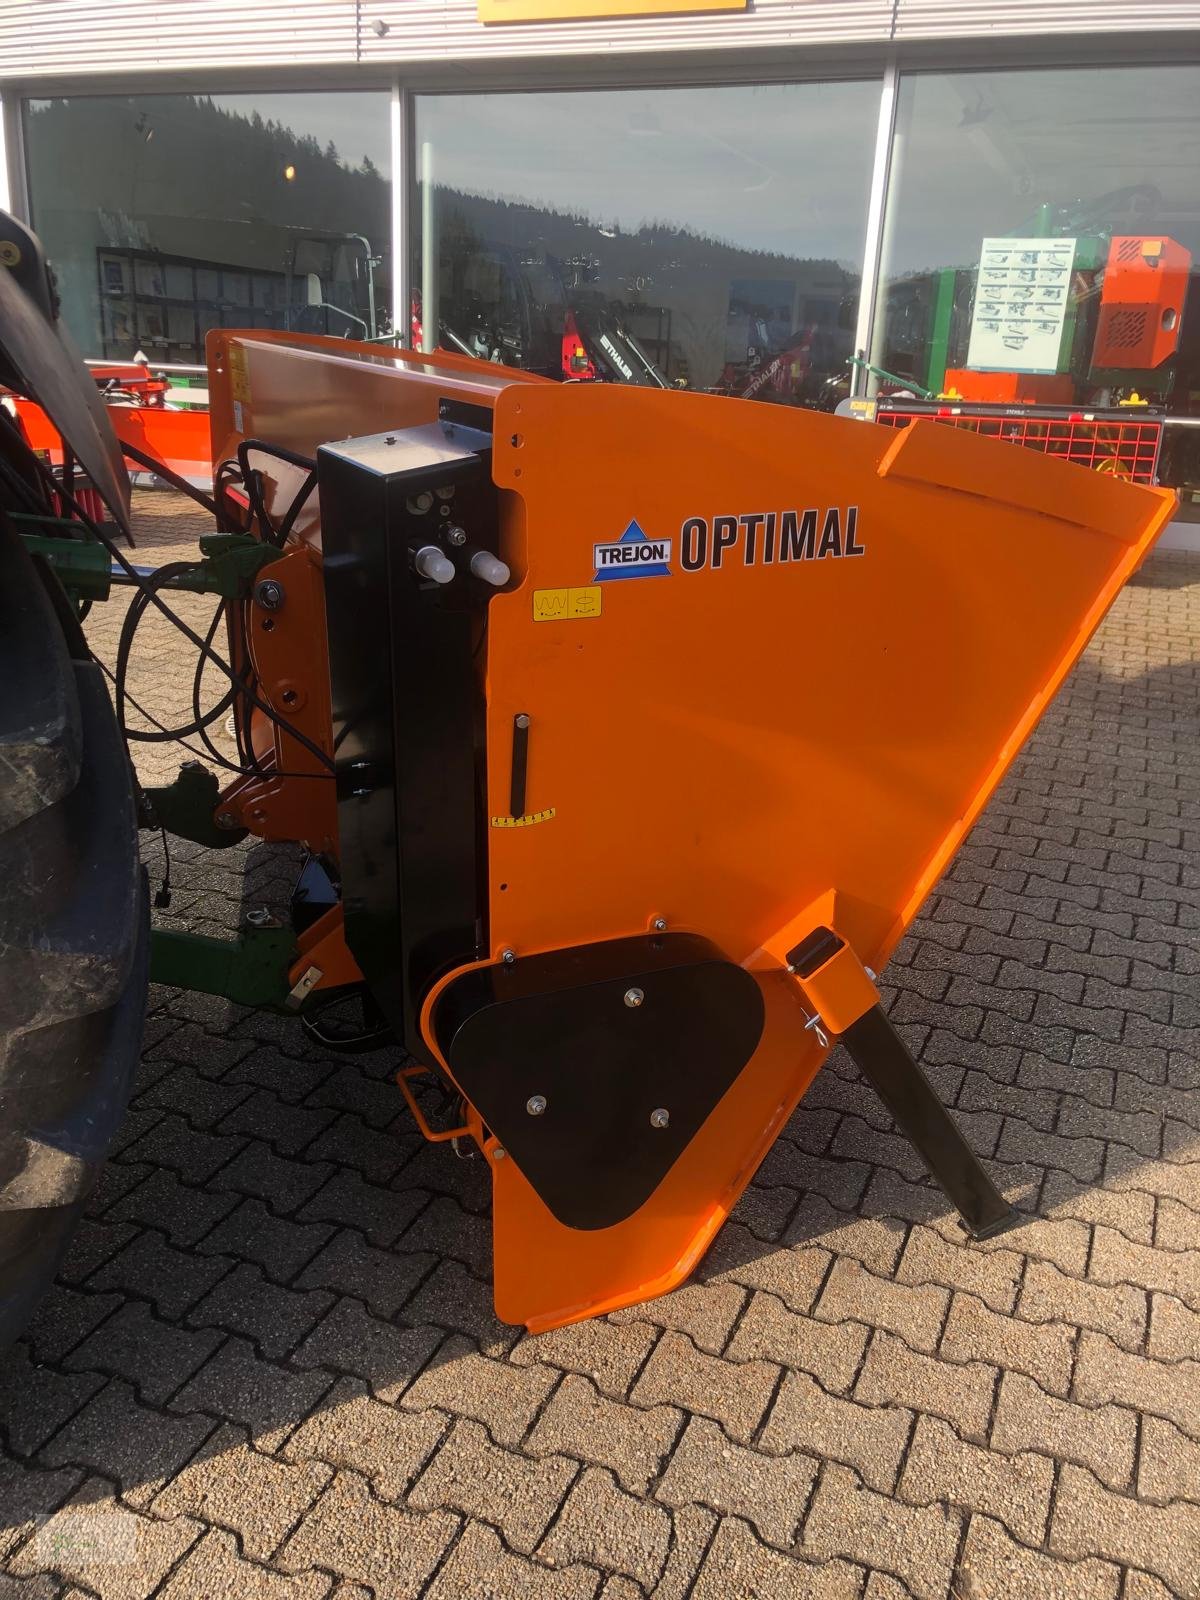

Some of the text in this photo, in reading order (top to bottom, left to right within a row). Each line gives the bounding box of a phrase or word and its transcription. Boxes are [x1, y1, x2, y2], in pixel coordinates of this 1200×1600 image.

[607, 343, 633, 380] THALER
[598, 544, 664, 565] TREJON
[680, 505, 865, 573] OPTIMAL
